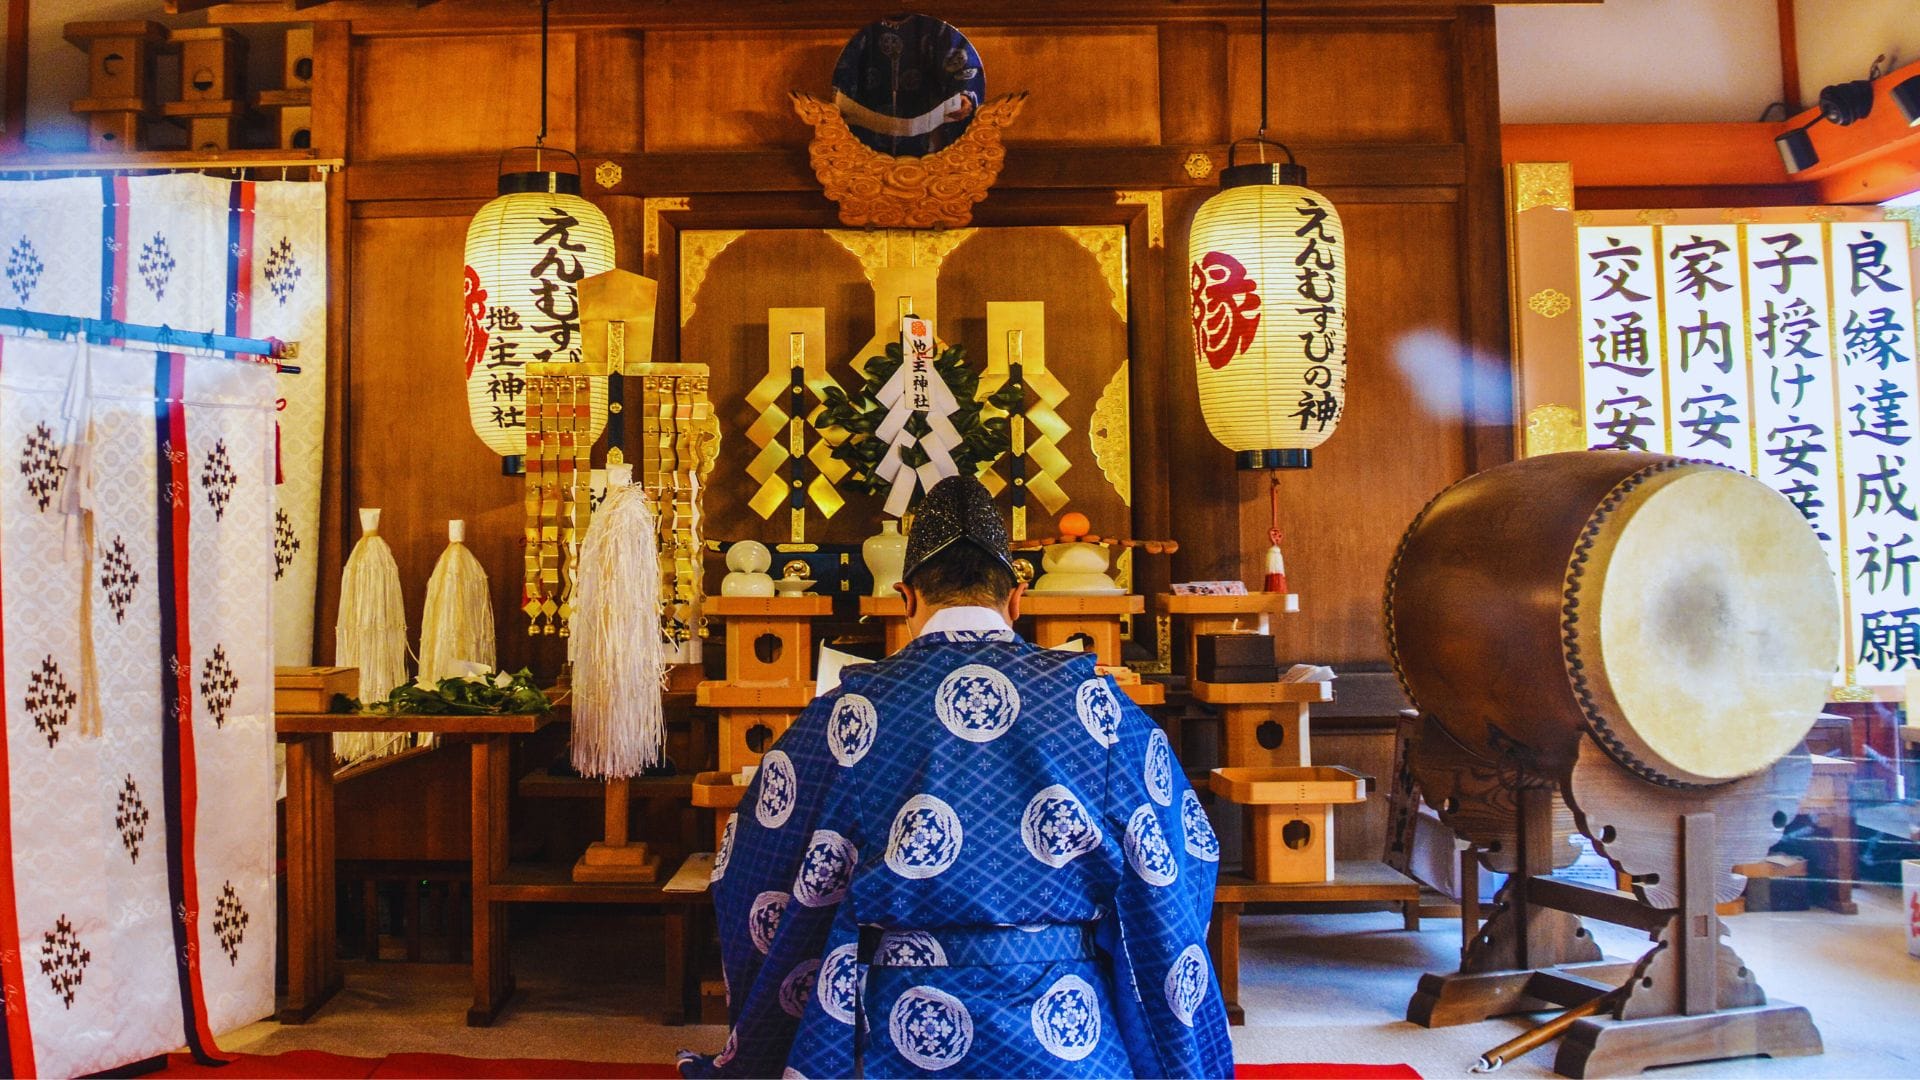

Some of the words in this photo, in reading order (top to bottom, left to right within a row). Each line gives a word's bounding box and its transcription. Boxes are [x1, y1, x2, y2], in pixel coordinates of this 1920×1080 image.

[485, 306, 527, 429] 地主神社
[912, 339, 930, 409] 地主神社
[1288, 197, 1338, 432] えんむすびの神
[1588, 236, 1656, 451] 交通安
[1669, 235, 1741, 449] 家内安
[1843, 230, 1920, 672] 良縁達成祈願
